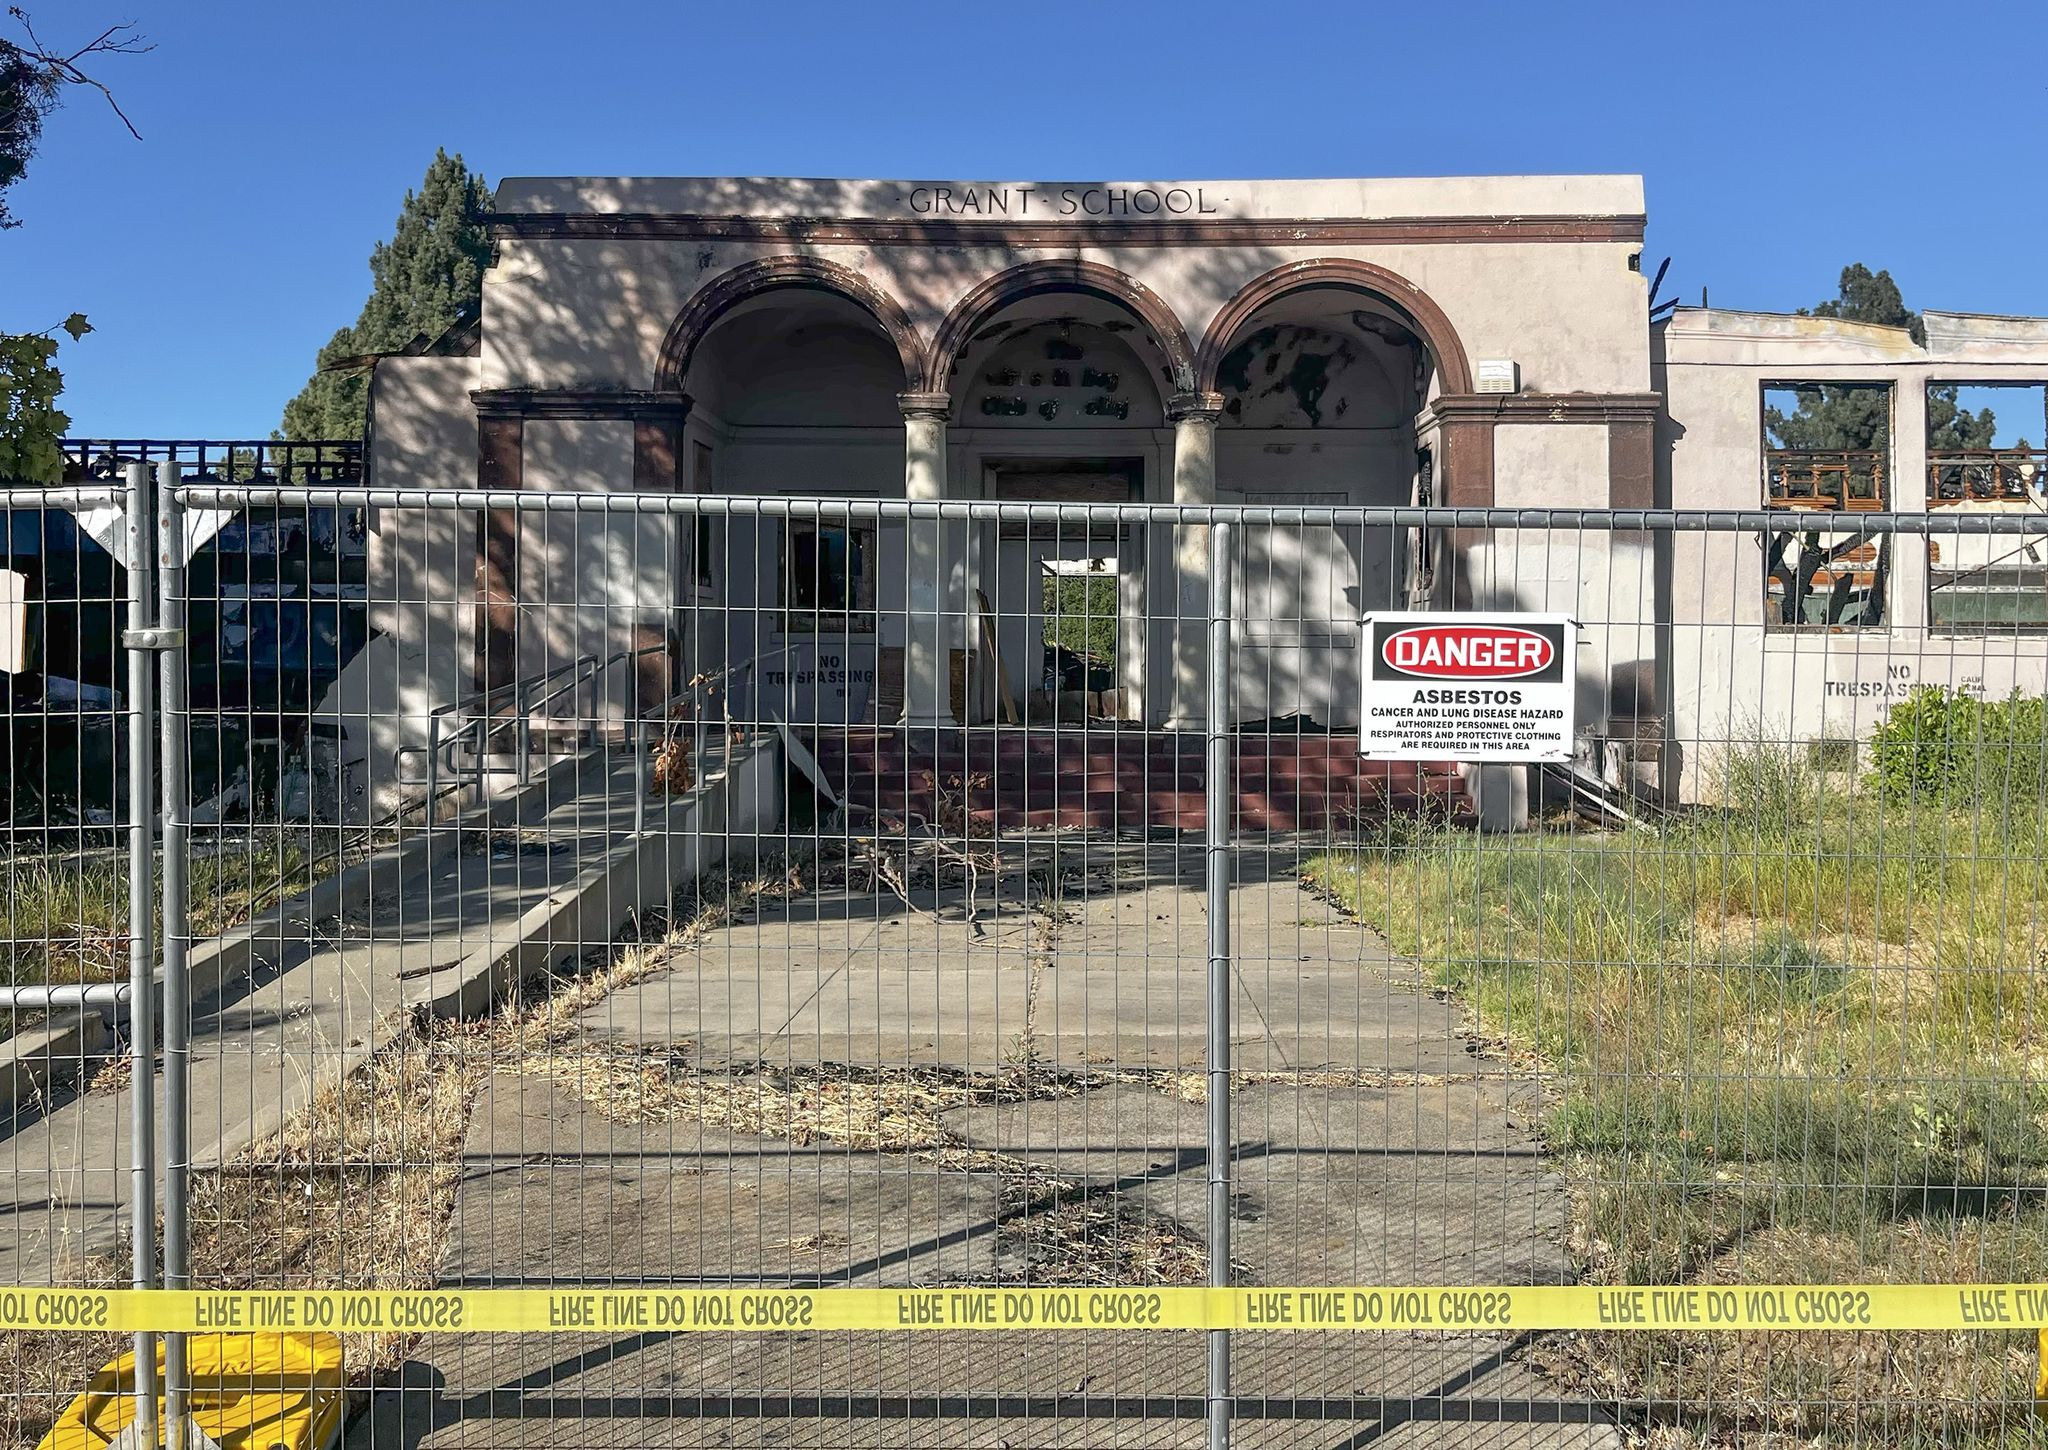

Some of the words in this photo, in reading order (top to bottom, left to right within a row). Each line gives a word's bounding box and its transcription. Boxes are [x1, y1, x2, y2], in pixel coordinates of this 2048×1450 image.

[909, 188, 1036, 214] GRANT
[1059, 188, 1217, 215] SCHOOL
[1395, 636, 1543, 668] DANGER
[819, 655, 840, 668] NO
[766, 670, 874, 685] TRESPASSING
[1888, 665, 1911, 679] NO
[1412, 689, 1522, 705] ASBESTOS
[1371, 707, 1414, 717] CANCER
[1416, 708, 1439, 717] AND
[1441, 708, 1470, 718] LUNG
[1473, 709, 1517, 718] DISEASE
[1520, 709, 1564, 719] HAZARD
[1396, 720, 1454, 728] AUTHORIZED
[1456, 721, 1510, 729] PERSONNEL
[1512, 722, 1536, 730] ONLY
[1370, 730, 1433, 739] RESPIRATORS
[1435, 731, 1454, 739] AND
[1456, 731, 1513, 740] PROTECTIVE
[1515, 732, 1561, 741] CLOTHING
[1401, 741, 1419, 749] ARE
[1421, 741, 1468, 750] REQUIRED
[1470, 742, 1480, 750] IN
[1482, 742, 1503, 750] THIS
[1505, 742, 1530, 750] AREA
